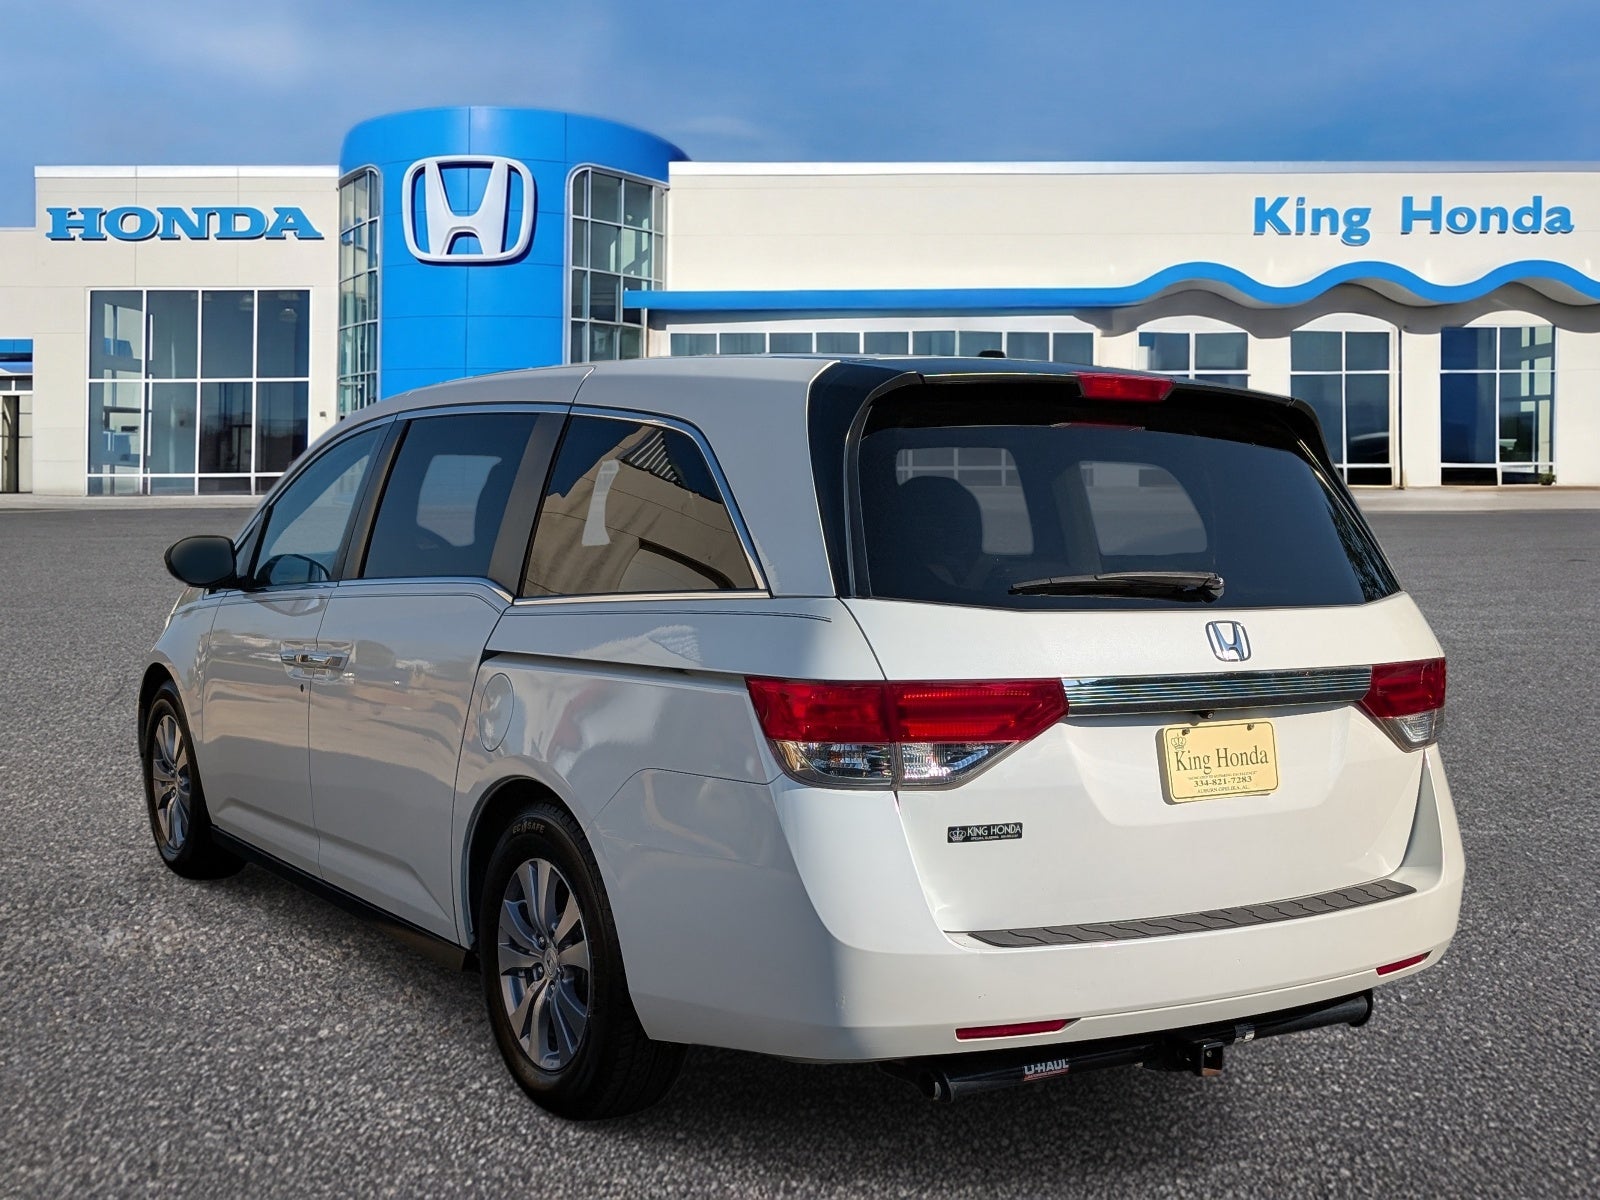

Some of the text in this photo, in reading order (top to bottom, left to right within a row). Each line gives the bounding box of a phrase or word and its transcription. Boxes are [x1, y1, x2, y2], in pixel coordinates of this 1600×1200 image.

[45, 206, 325, 241] HONDA
[1253, 195, 1574, 246] King Honda
[1175, 745, 1269, 775] King Honda
[1193, 775, 1253, 788] 334-821-7283
[967, 826, 989, 837] KING
[990, 824, 1022, 836] HONDA
[1023, 1058, 1070, 1075] U-HAUL
